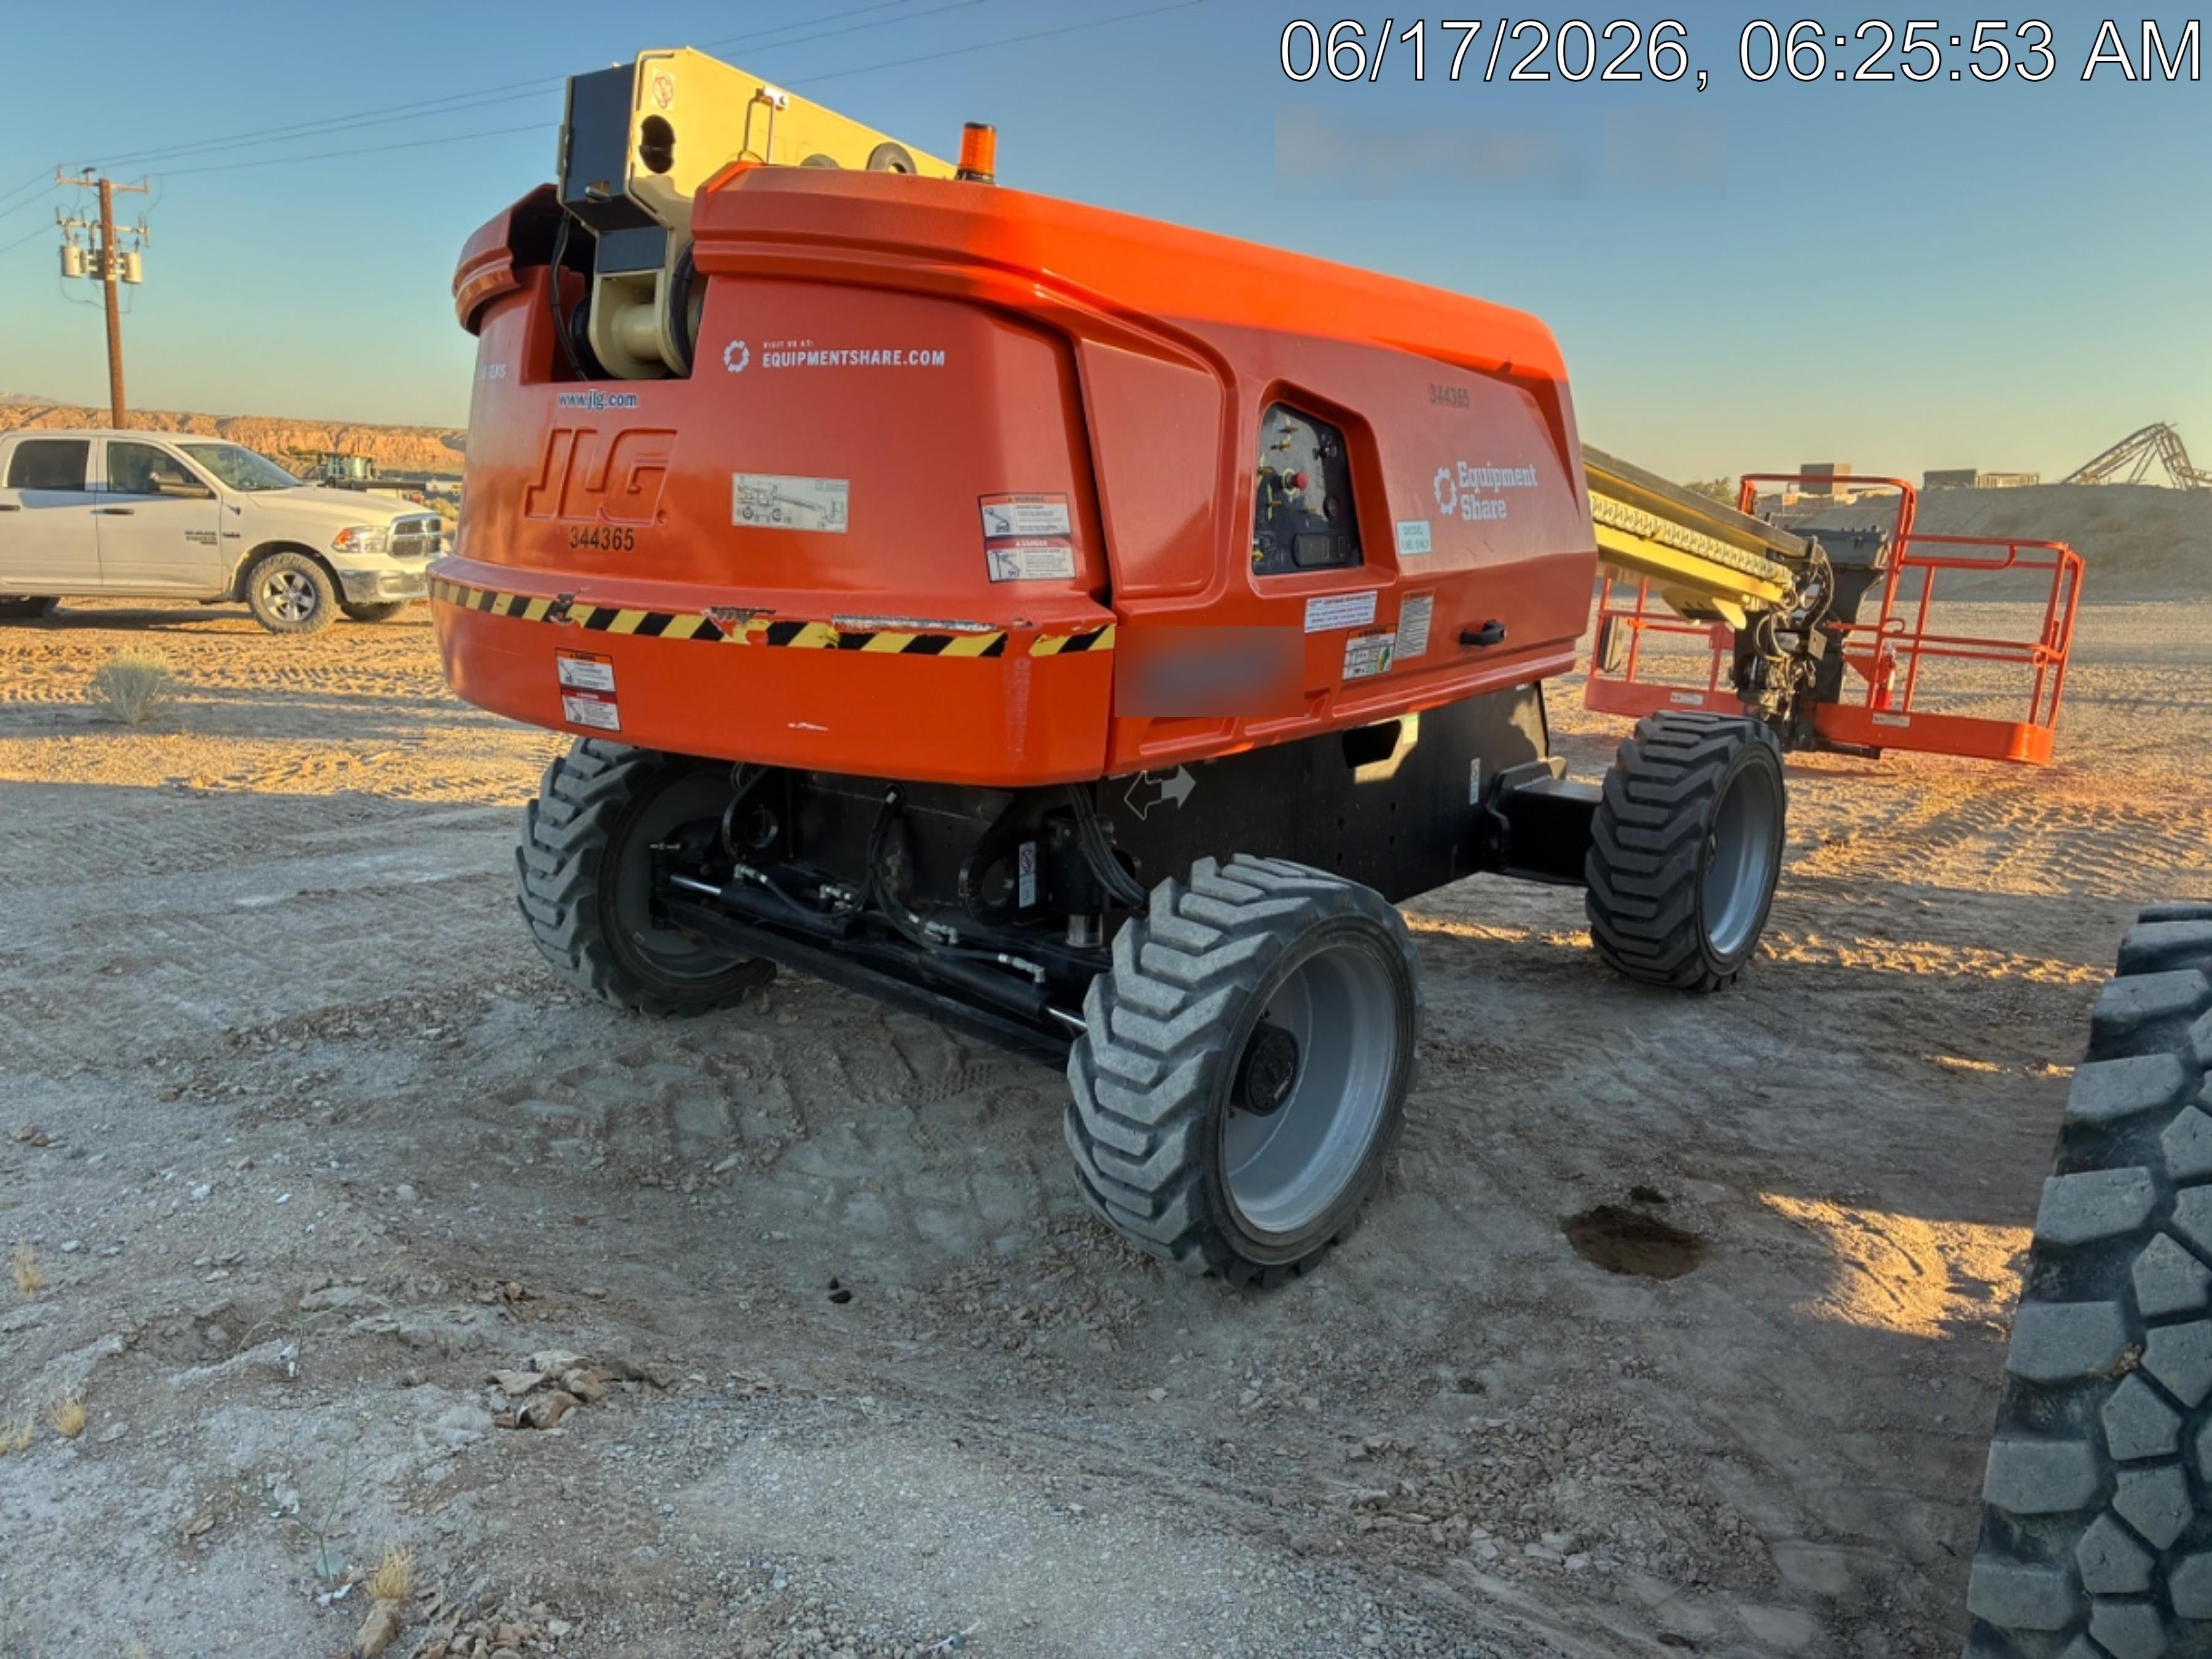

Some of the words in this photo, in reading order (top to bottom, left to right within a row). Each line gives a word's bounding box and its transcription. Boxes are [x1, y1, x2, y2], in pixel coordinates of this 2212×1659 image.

[763, 349, 945, 367] EQUIPMENTSHARE.COM
[559, 390, 637, 411] www.jlg.com
[1429, 383, 1470, 409] 344365
[524, 428, 678, 527] JLG
[1457, 461, 1538, 493] Equipment
[1461, 494, 1507, 521] Share
[570, 526, 635, 551] 344365
